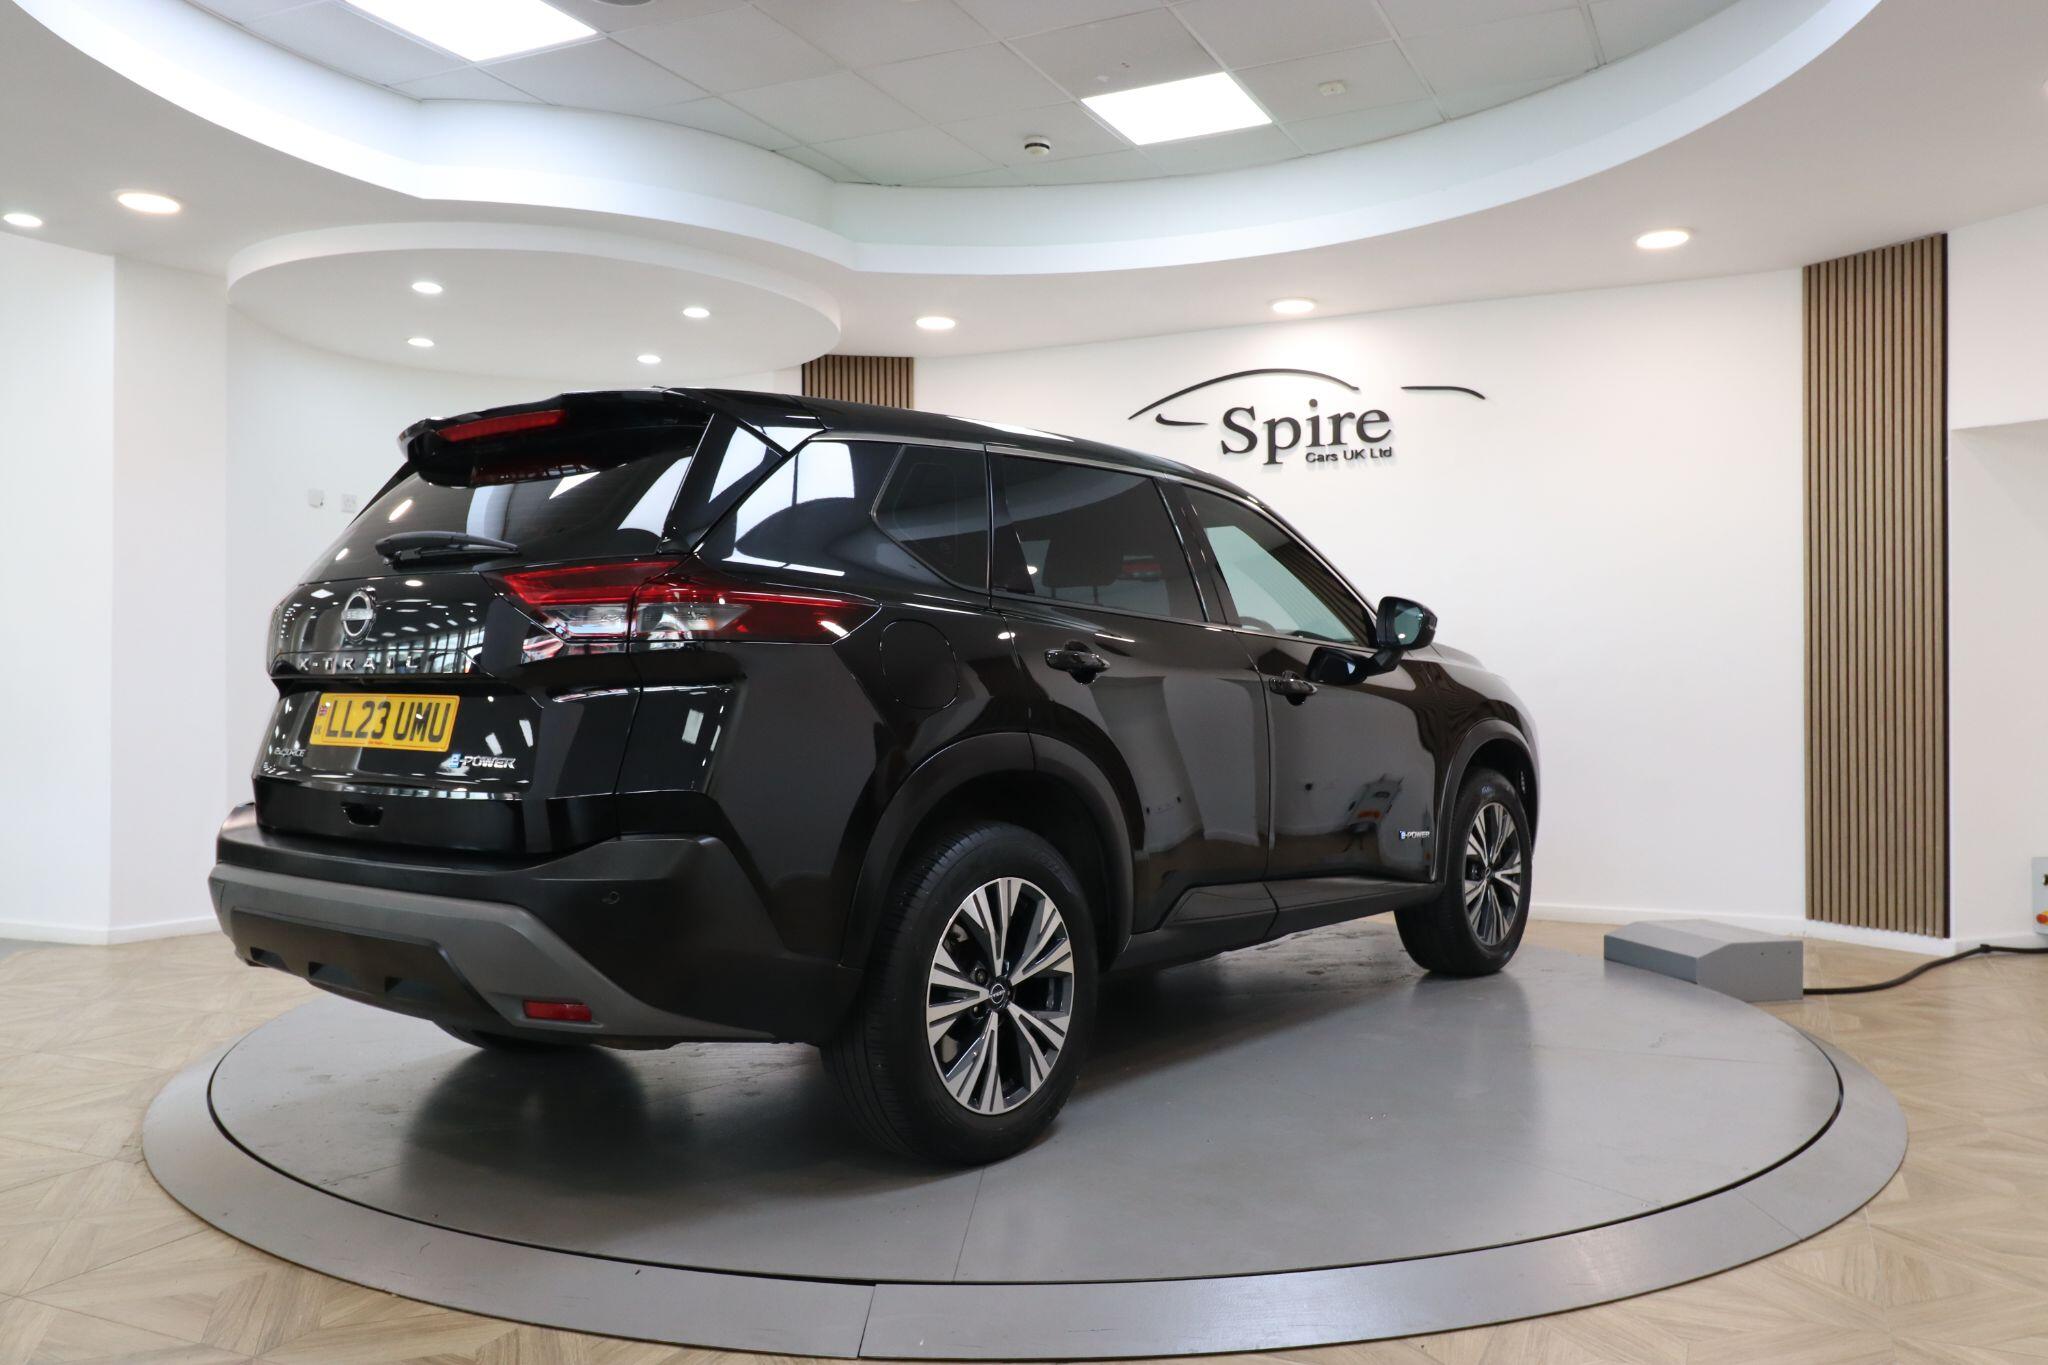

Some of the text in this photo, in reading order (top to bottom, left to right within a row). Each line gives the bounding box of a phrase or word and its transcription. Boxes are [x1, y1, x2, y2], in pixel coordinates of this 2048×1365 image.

[1220, 398, 1392, 466] Spire
[1305, 446, 1392, 463] Cars UK Ltd
[299, 655, 419, 671] X-TRAIL
[325, 700, 451, 742] LL23 UMU
